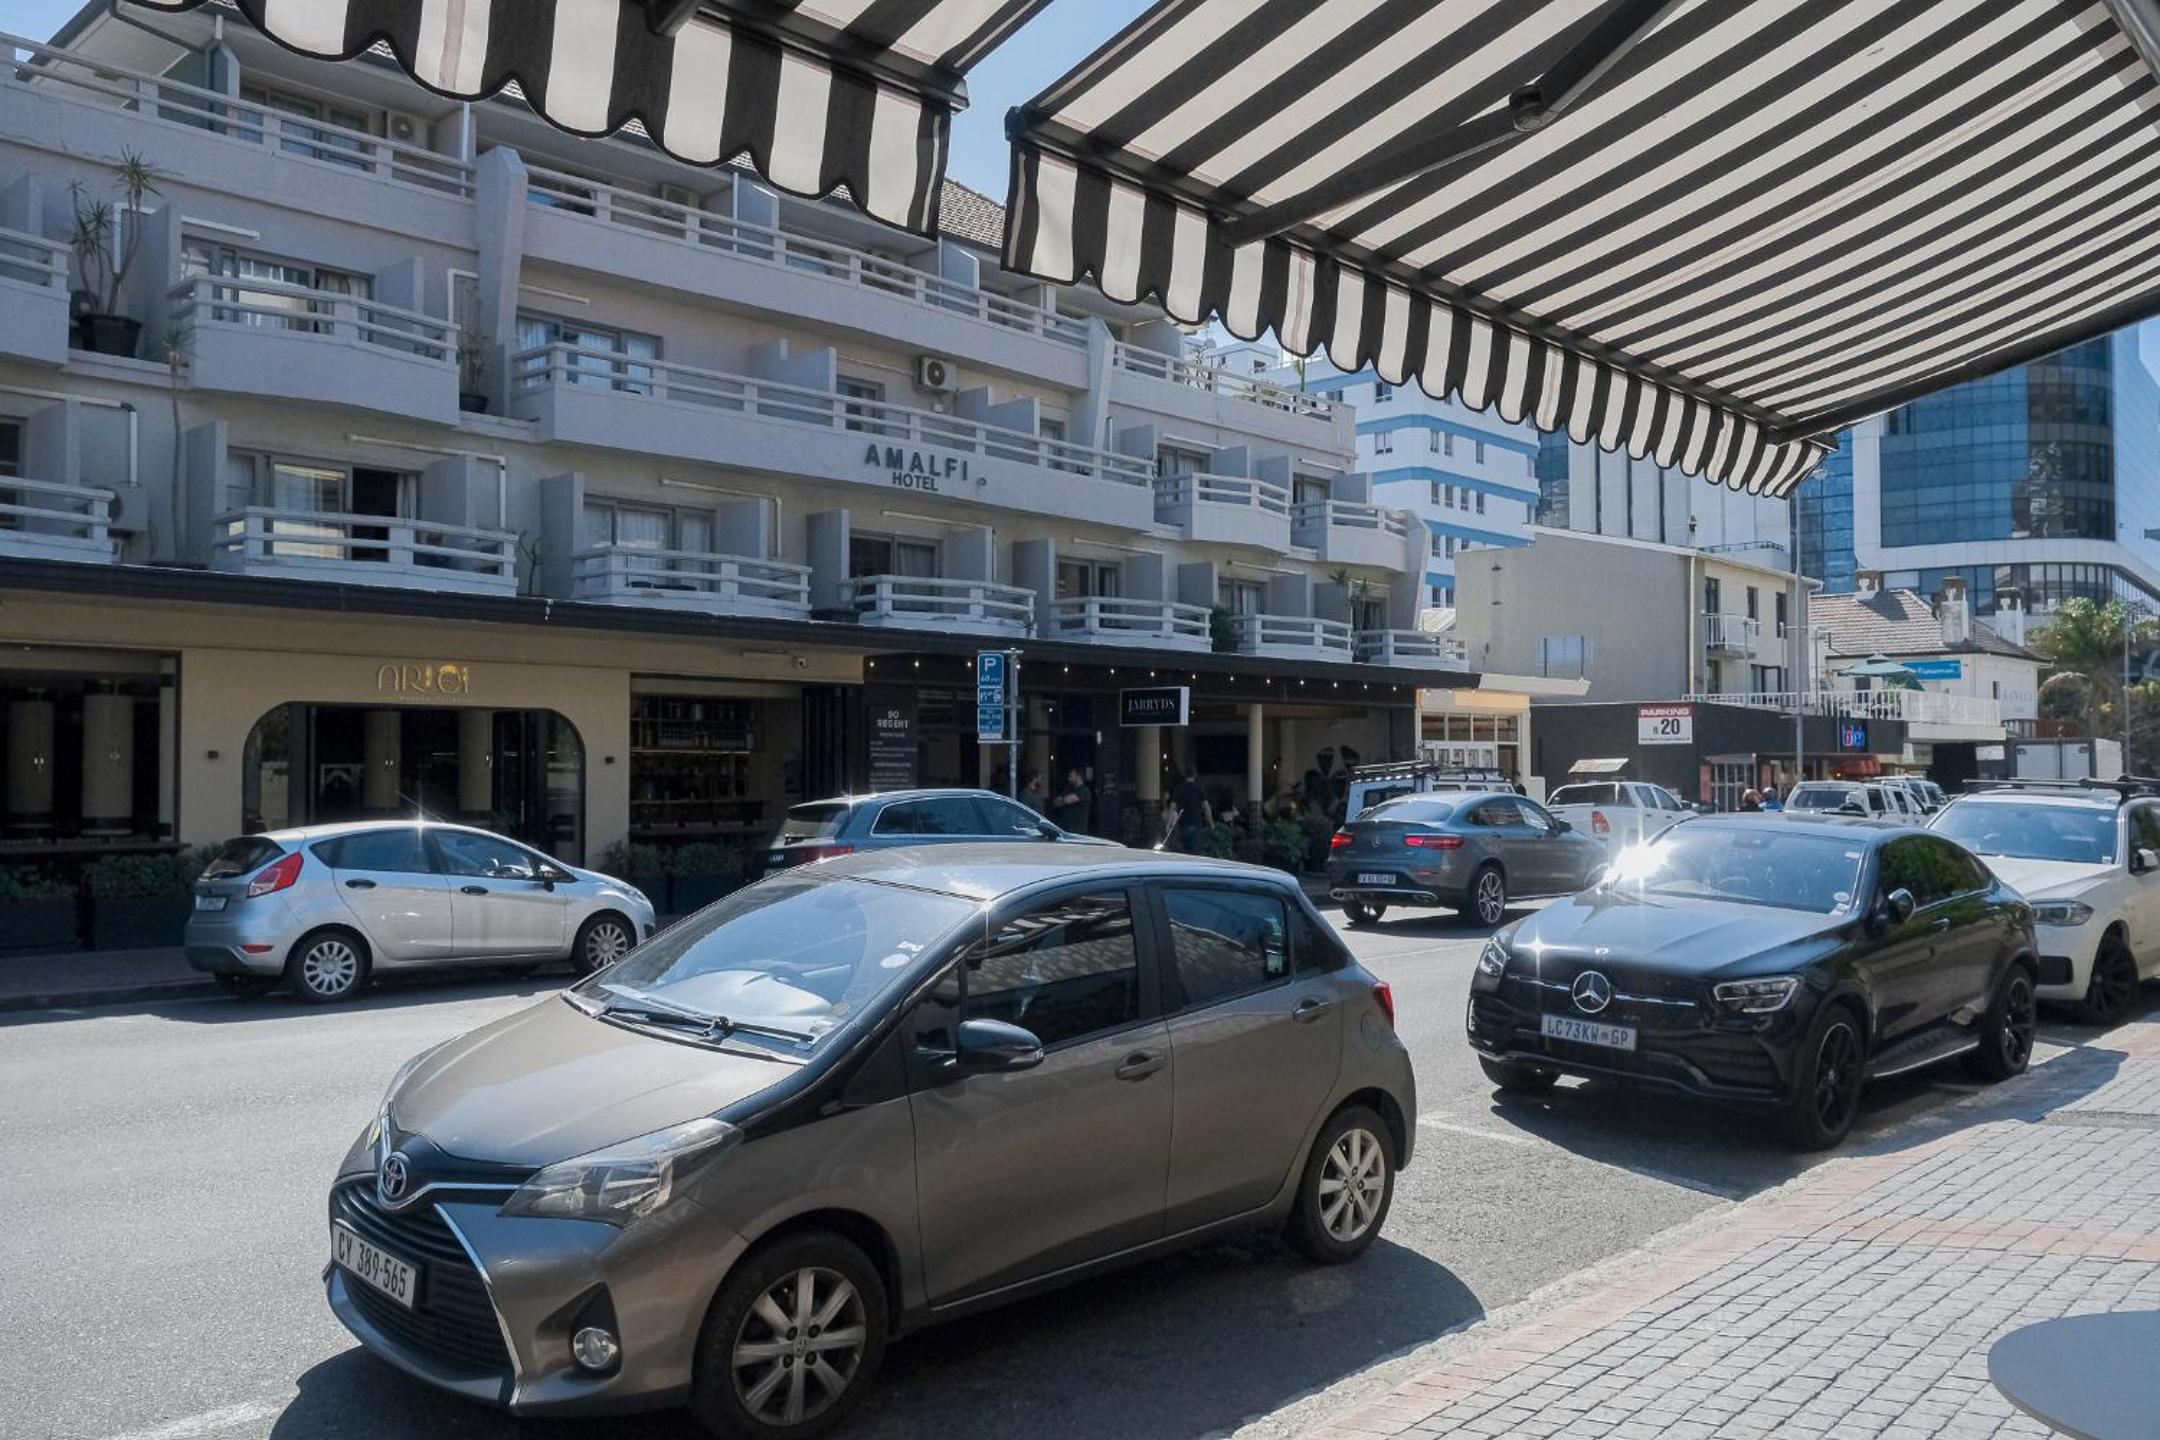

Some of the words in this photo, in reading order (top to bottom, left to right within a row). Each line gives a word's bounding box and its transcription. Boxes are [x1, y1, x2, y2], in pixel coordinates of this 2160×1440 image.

[865, 443, 968, 481] AMALFI
[892, 471, 939, 492] HOTEL
[984, 657, 997, 672] P
[1128, 697, 1175, 713] JARRYDS
[1640, 707, 1690, 717] PARKING
[1660, 718, 1681, 735] 20
[338, 1232, 353, 1265] CY
[357, 1242, 407, 1298] 389-565
